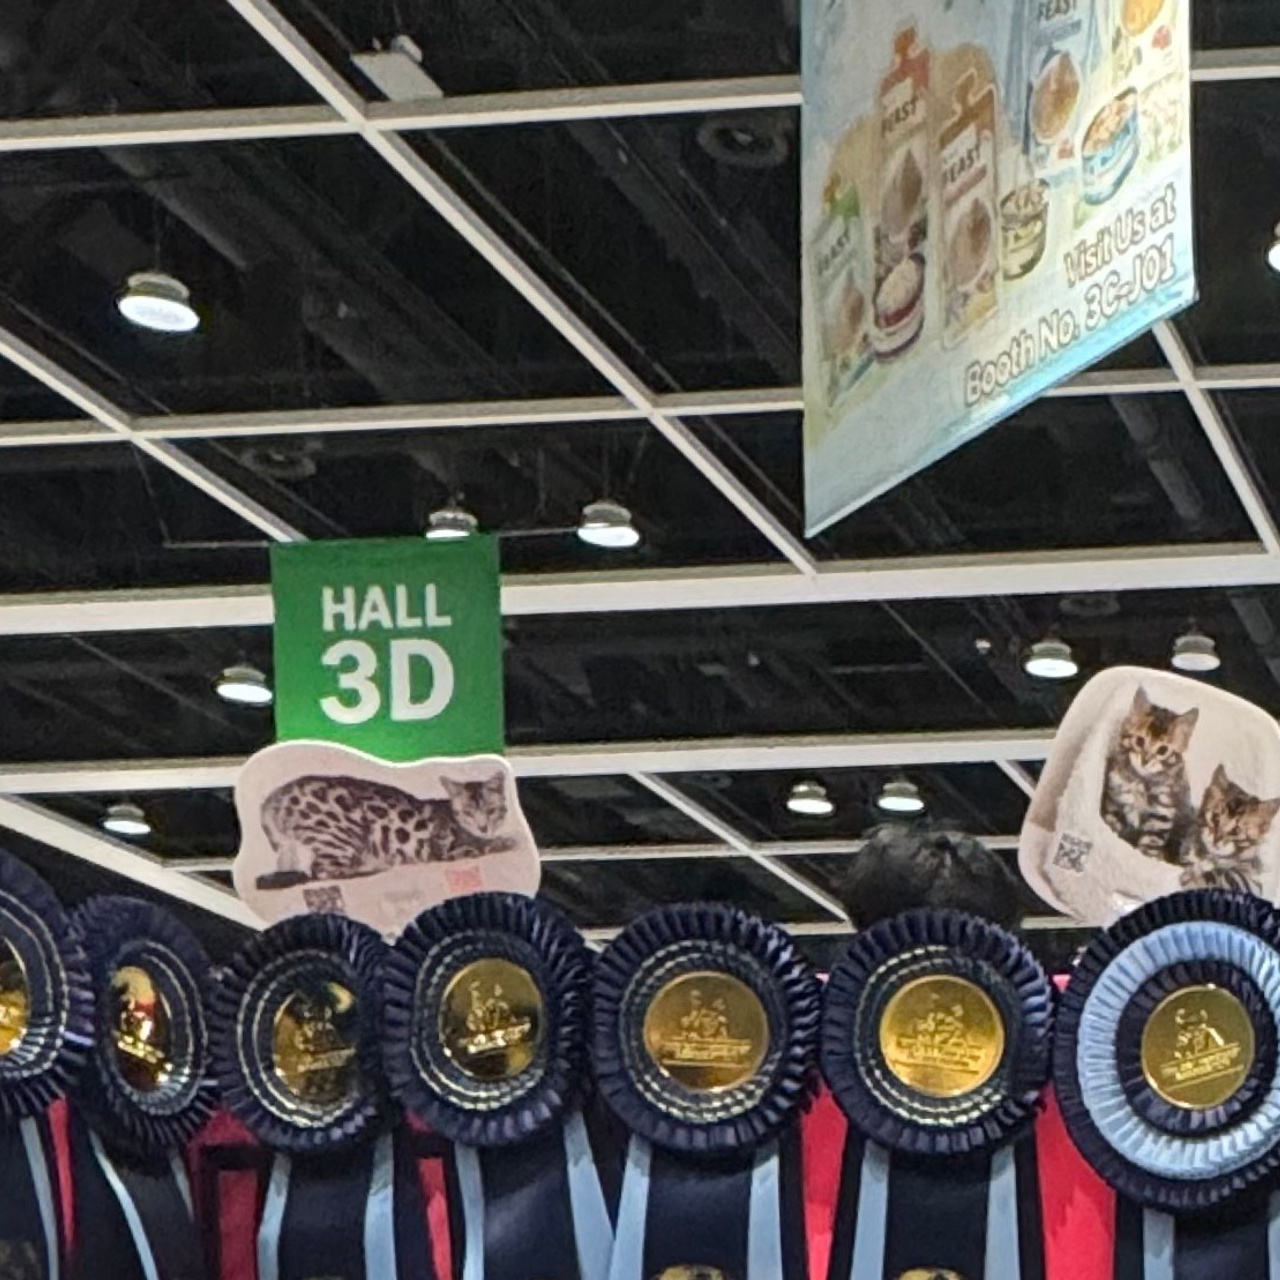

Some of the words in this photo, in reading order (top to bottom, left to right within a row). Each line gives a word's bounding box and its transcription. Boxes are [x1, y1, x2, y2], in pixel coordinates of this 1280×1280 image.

[1063, 226, 1112, 288] Visit
[1114, 207, 1146, 254] Us
[1150, 181, 1177, 232] at
[964, 329, 1036, 407] Booth
[1037, 308, 1081, 361] No.
[321, 582, 453, 632] HALL
[319, 637, 455, 725] 3D
